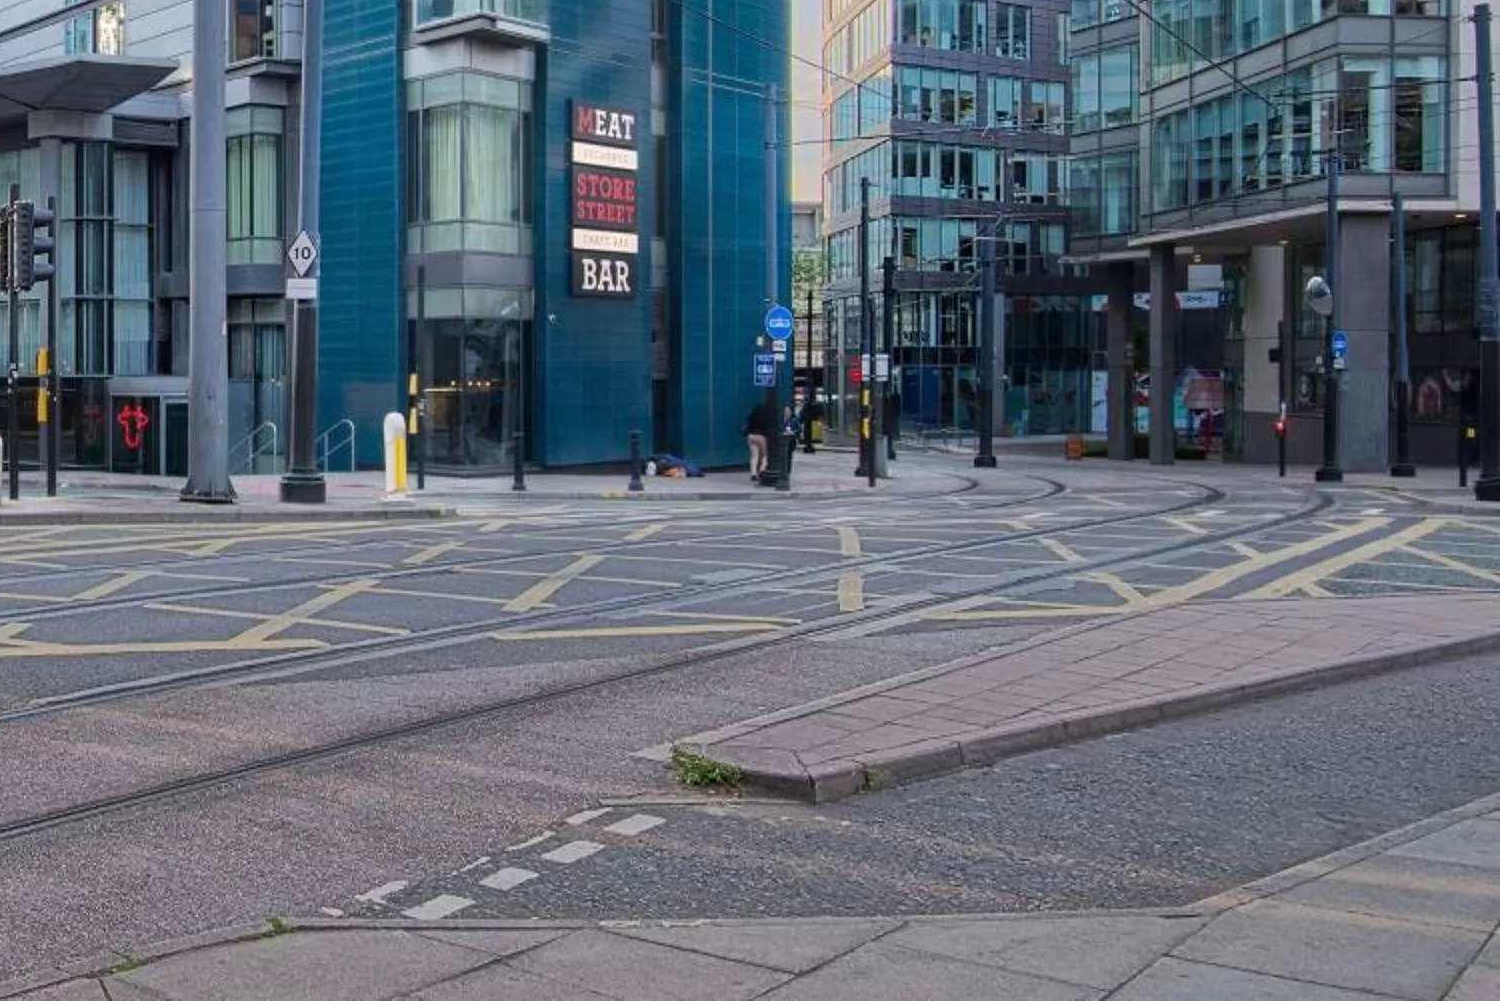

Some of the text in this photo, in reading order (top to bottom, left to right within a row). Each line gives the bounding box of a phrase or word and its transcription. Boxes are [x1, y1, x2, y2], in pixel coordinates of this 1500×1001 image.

[577, 106, 635, 141] MEAT
[577, 173, 636, 201] STORE
[577, 199, 636, 224] STREET
[294, 246, 311, 260] 10
[581, 257, 632, 293] BAR
